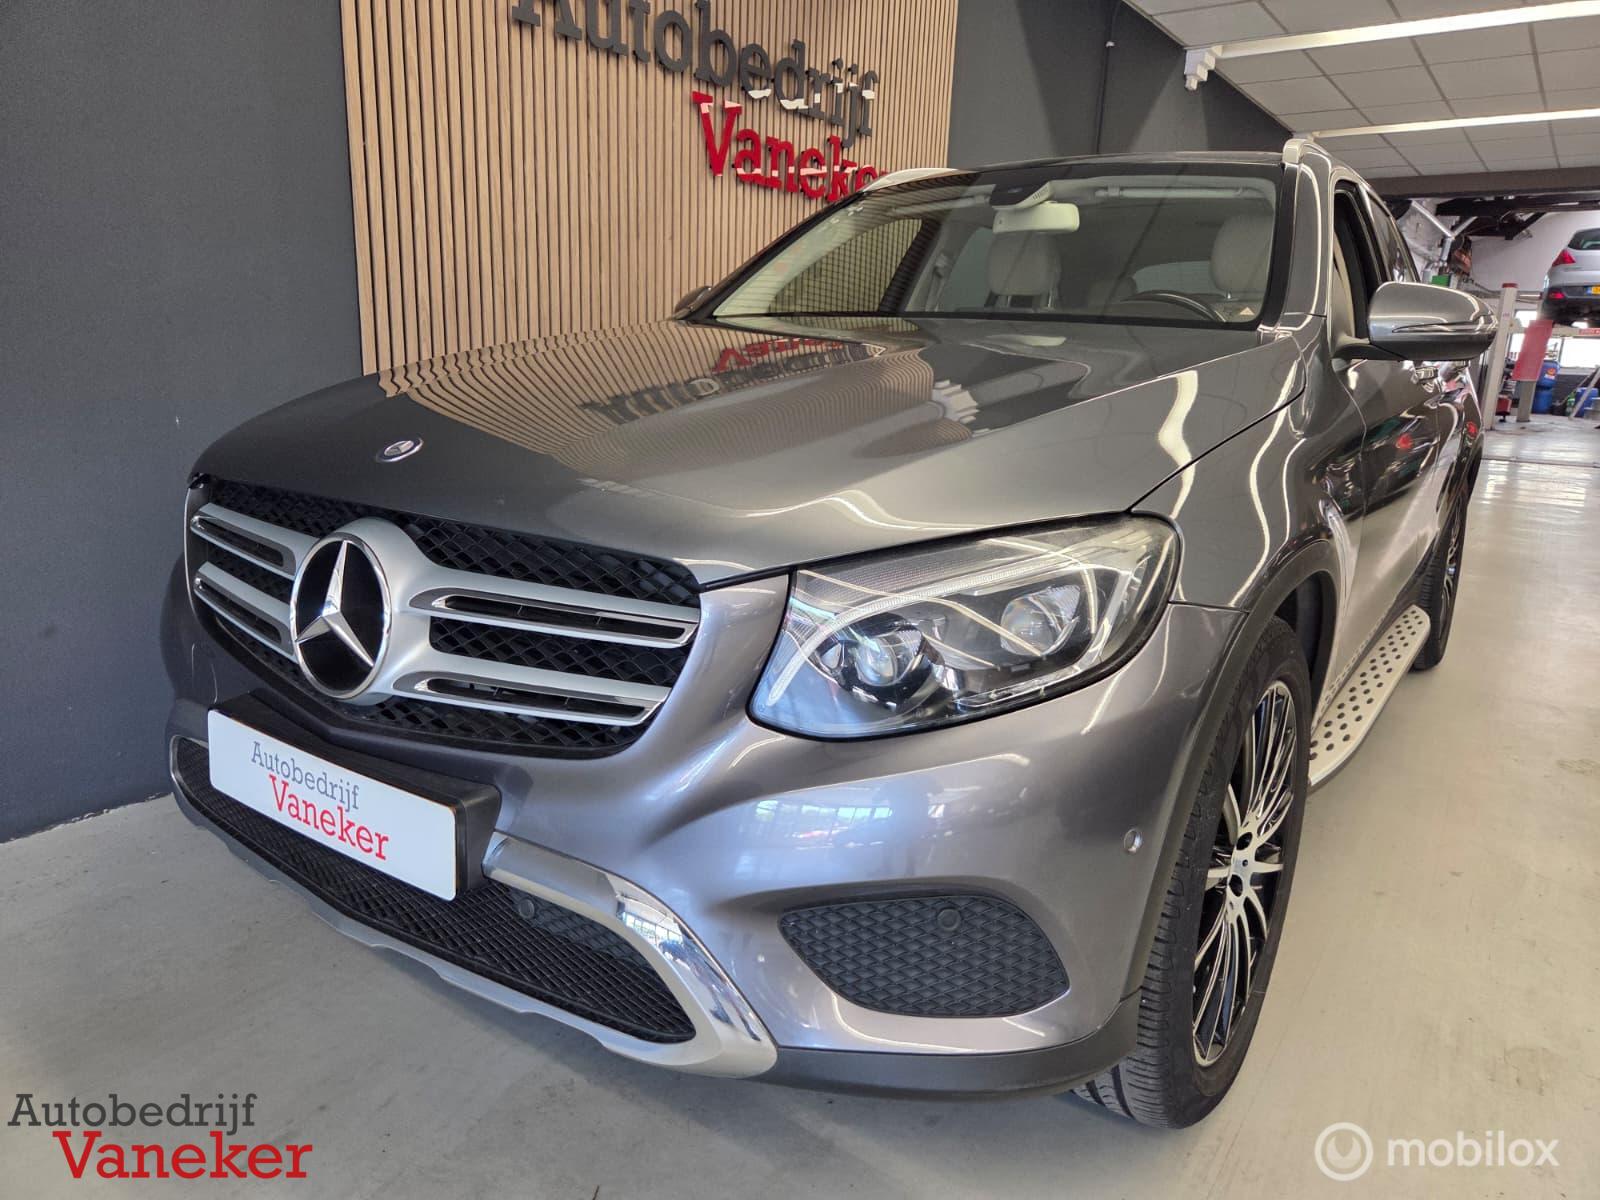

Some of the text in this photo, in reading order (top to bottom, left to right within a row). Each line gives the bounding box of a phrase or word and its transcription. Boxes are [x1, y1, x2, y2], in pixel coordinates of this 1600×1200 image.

[692, 91, 888, 202] Vanek
[251, 741, 359, 812] Autobedrijf
[269, 774, 389, 860] Vaneker
